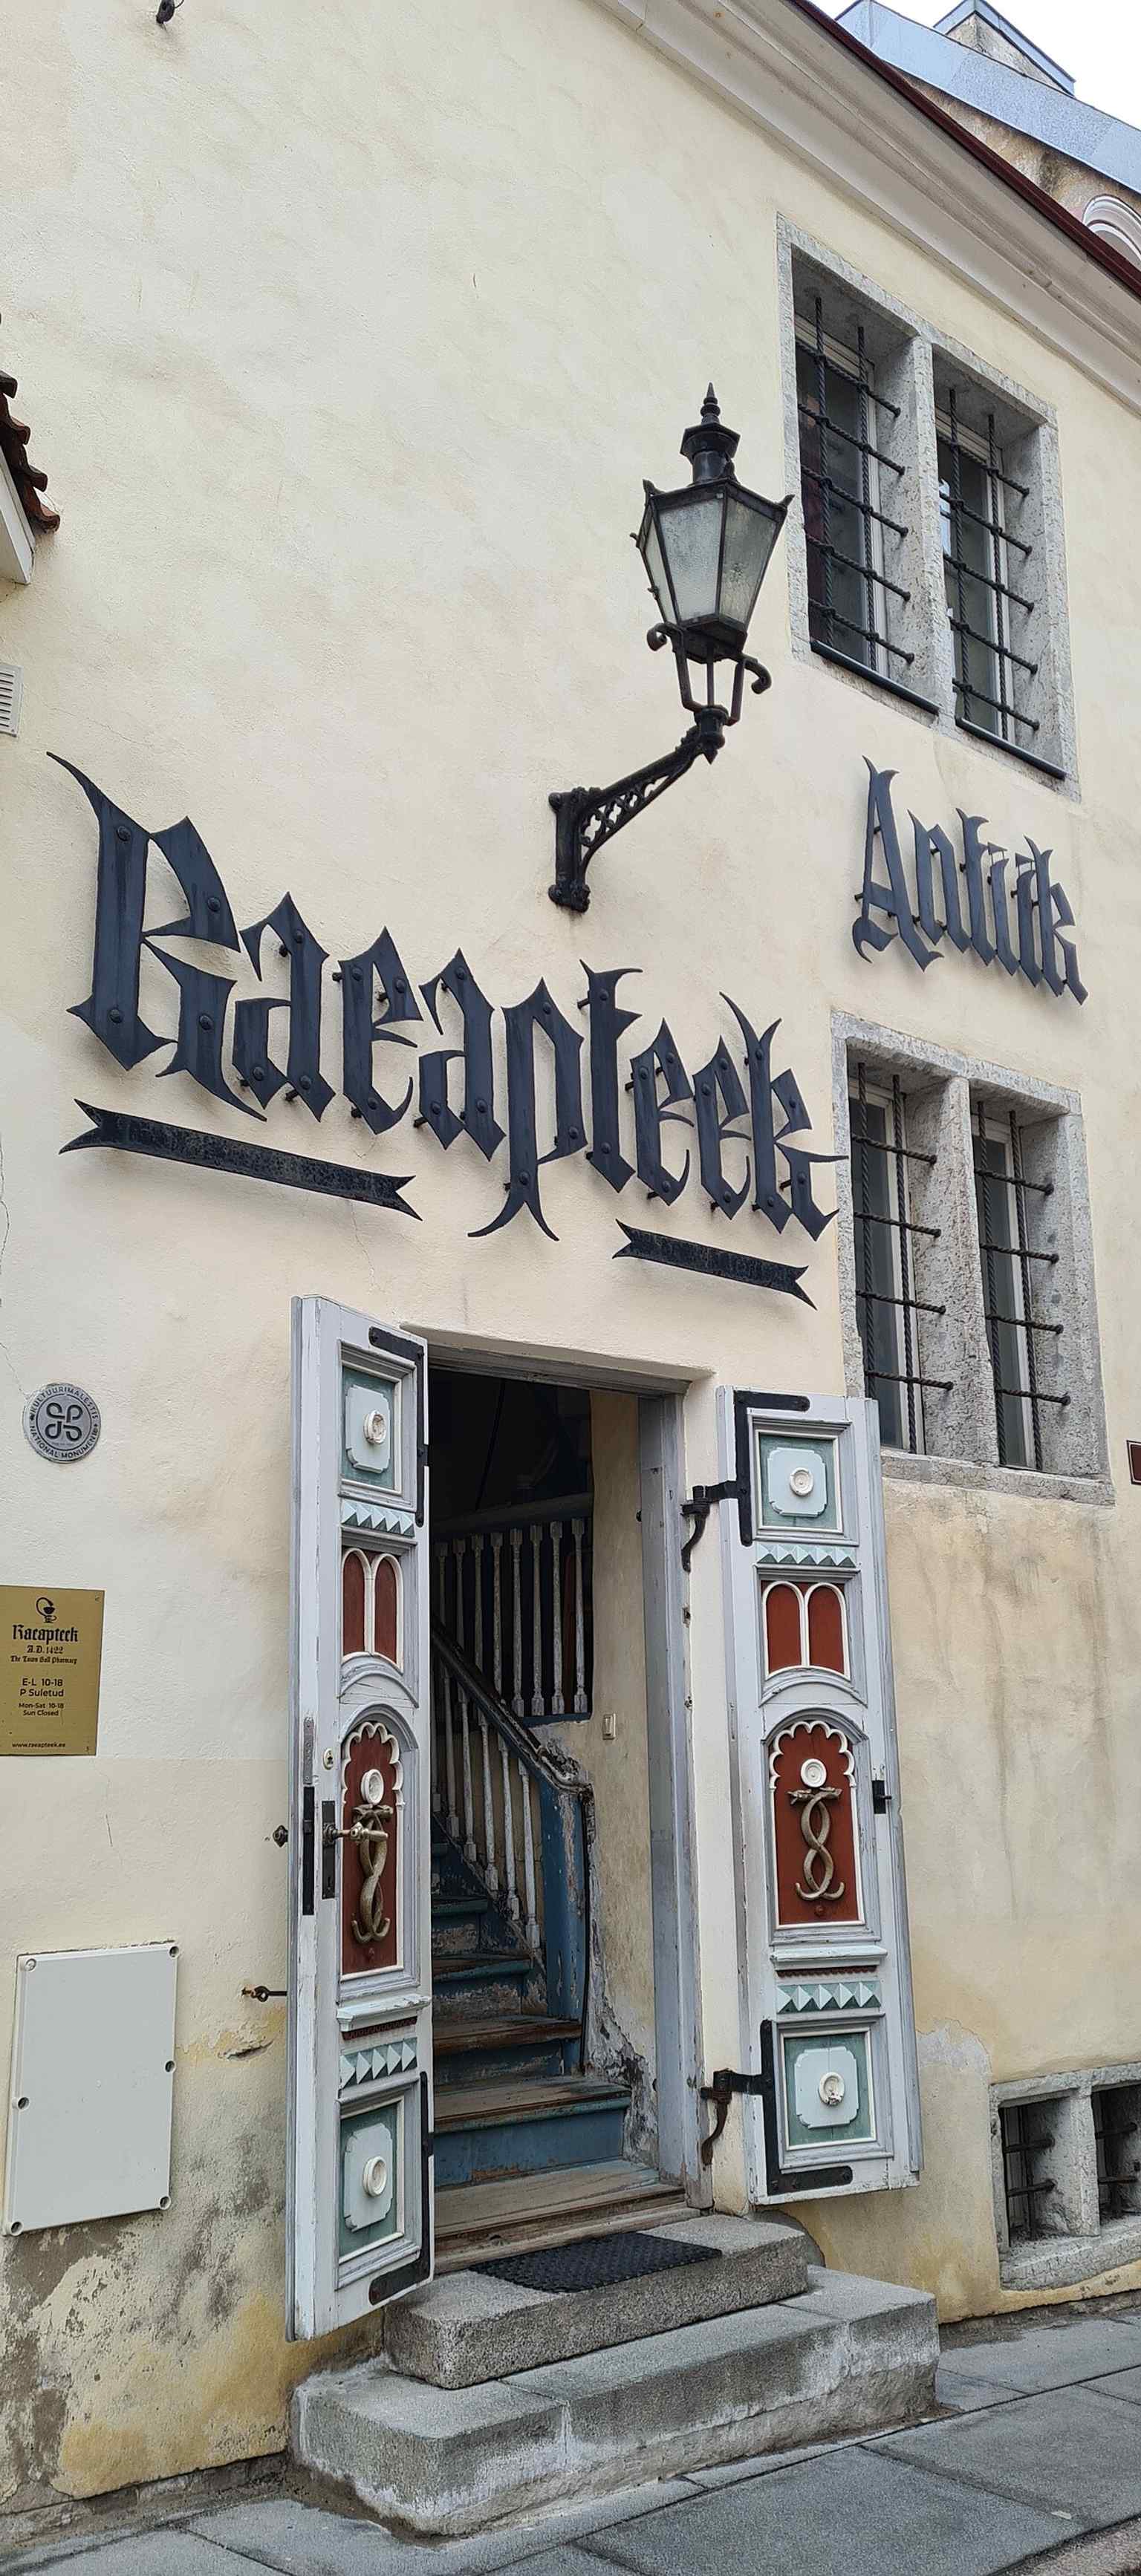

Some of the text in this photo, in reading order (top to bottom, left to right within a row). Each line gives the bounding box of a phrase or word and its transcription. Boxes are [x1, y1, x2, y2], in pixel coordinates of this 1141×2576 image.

[852, 755, 1089, 1005] Antiik
[47, 751, 848, 1241] Raeapteek
[30, 1425, 59, 1458] NATIONAL
[13, 1624, 78, 1645] Raeapteek
[22, 1678, 63, 1686] E-L 10-18
[28, 1689, 64, 1697] Suletud
